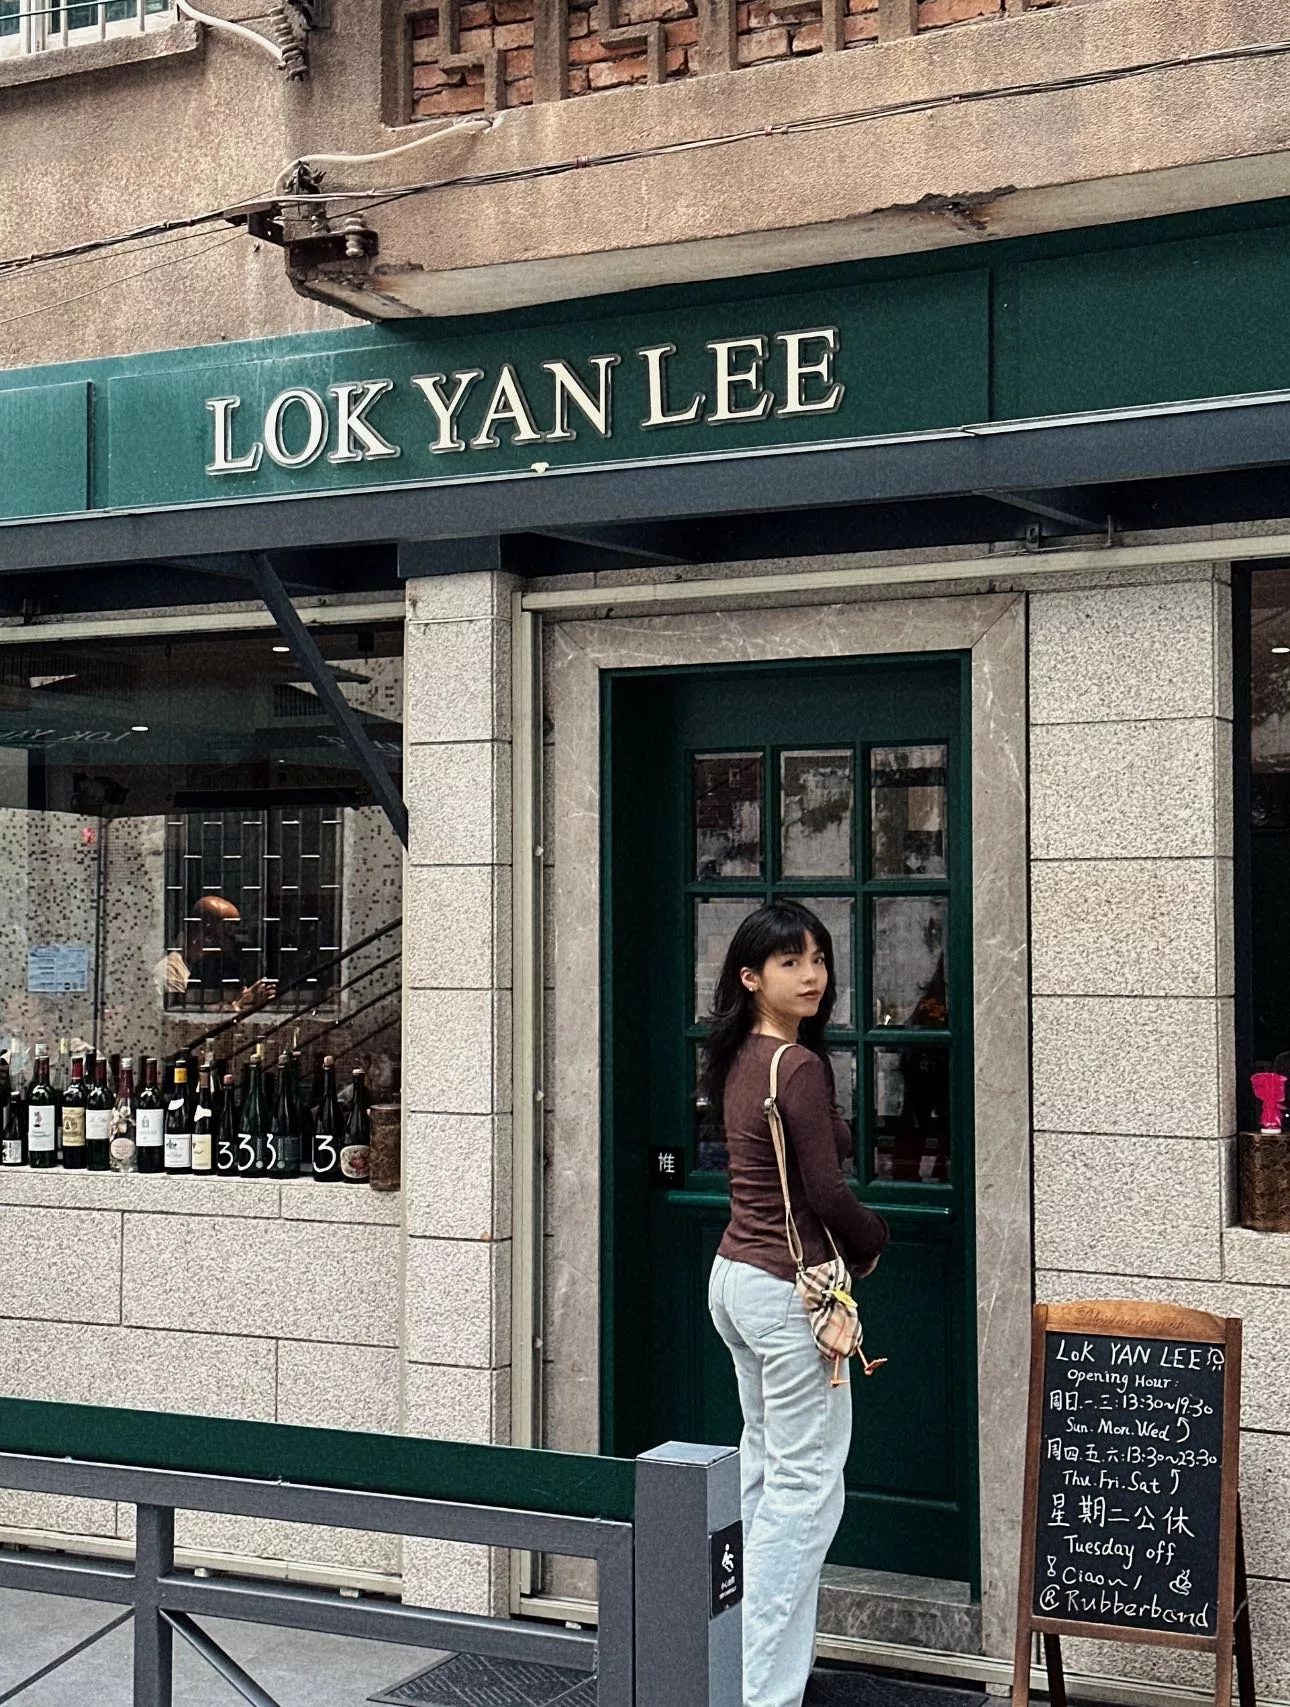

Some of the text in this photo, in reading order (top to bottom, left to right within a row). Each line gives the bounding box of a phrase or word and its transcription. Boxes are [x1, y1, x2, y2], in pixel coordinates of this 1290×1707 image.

[205, 326, 847, 475] LOK YAN LEE
[217, 1141, 234, 1170] 3
[313, 1134, 337, 1173] 3
[1111, 1342, 1151, 1366] YAN
[1159, 1346, 1202, 1370] LEE
[1063, 1534, 1176, 1570] Tuesday off
